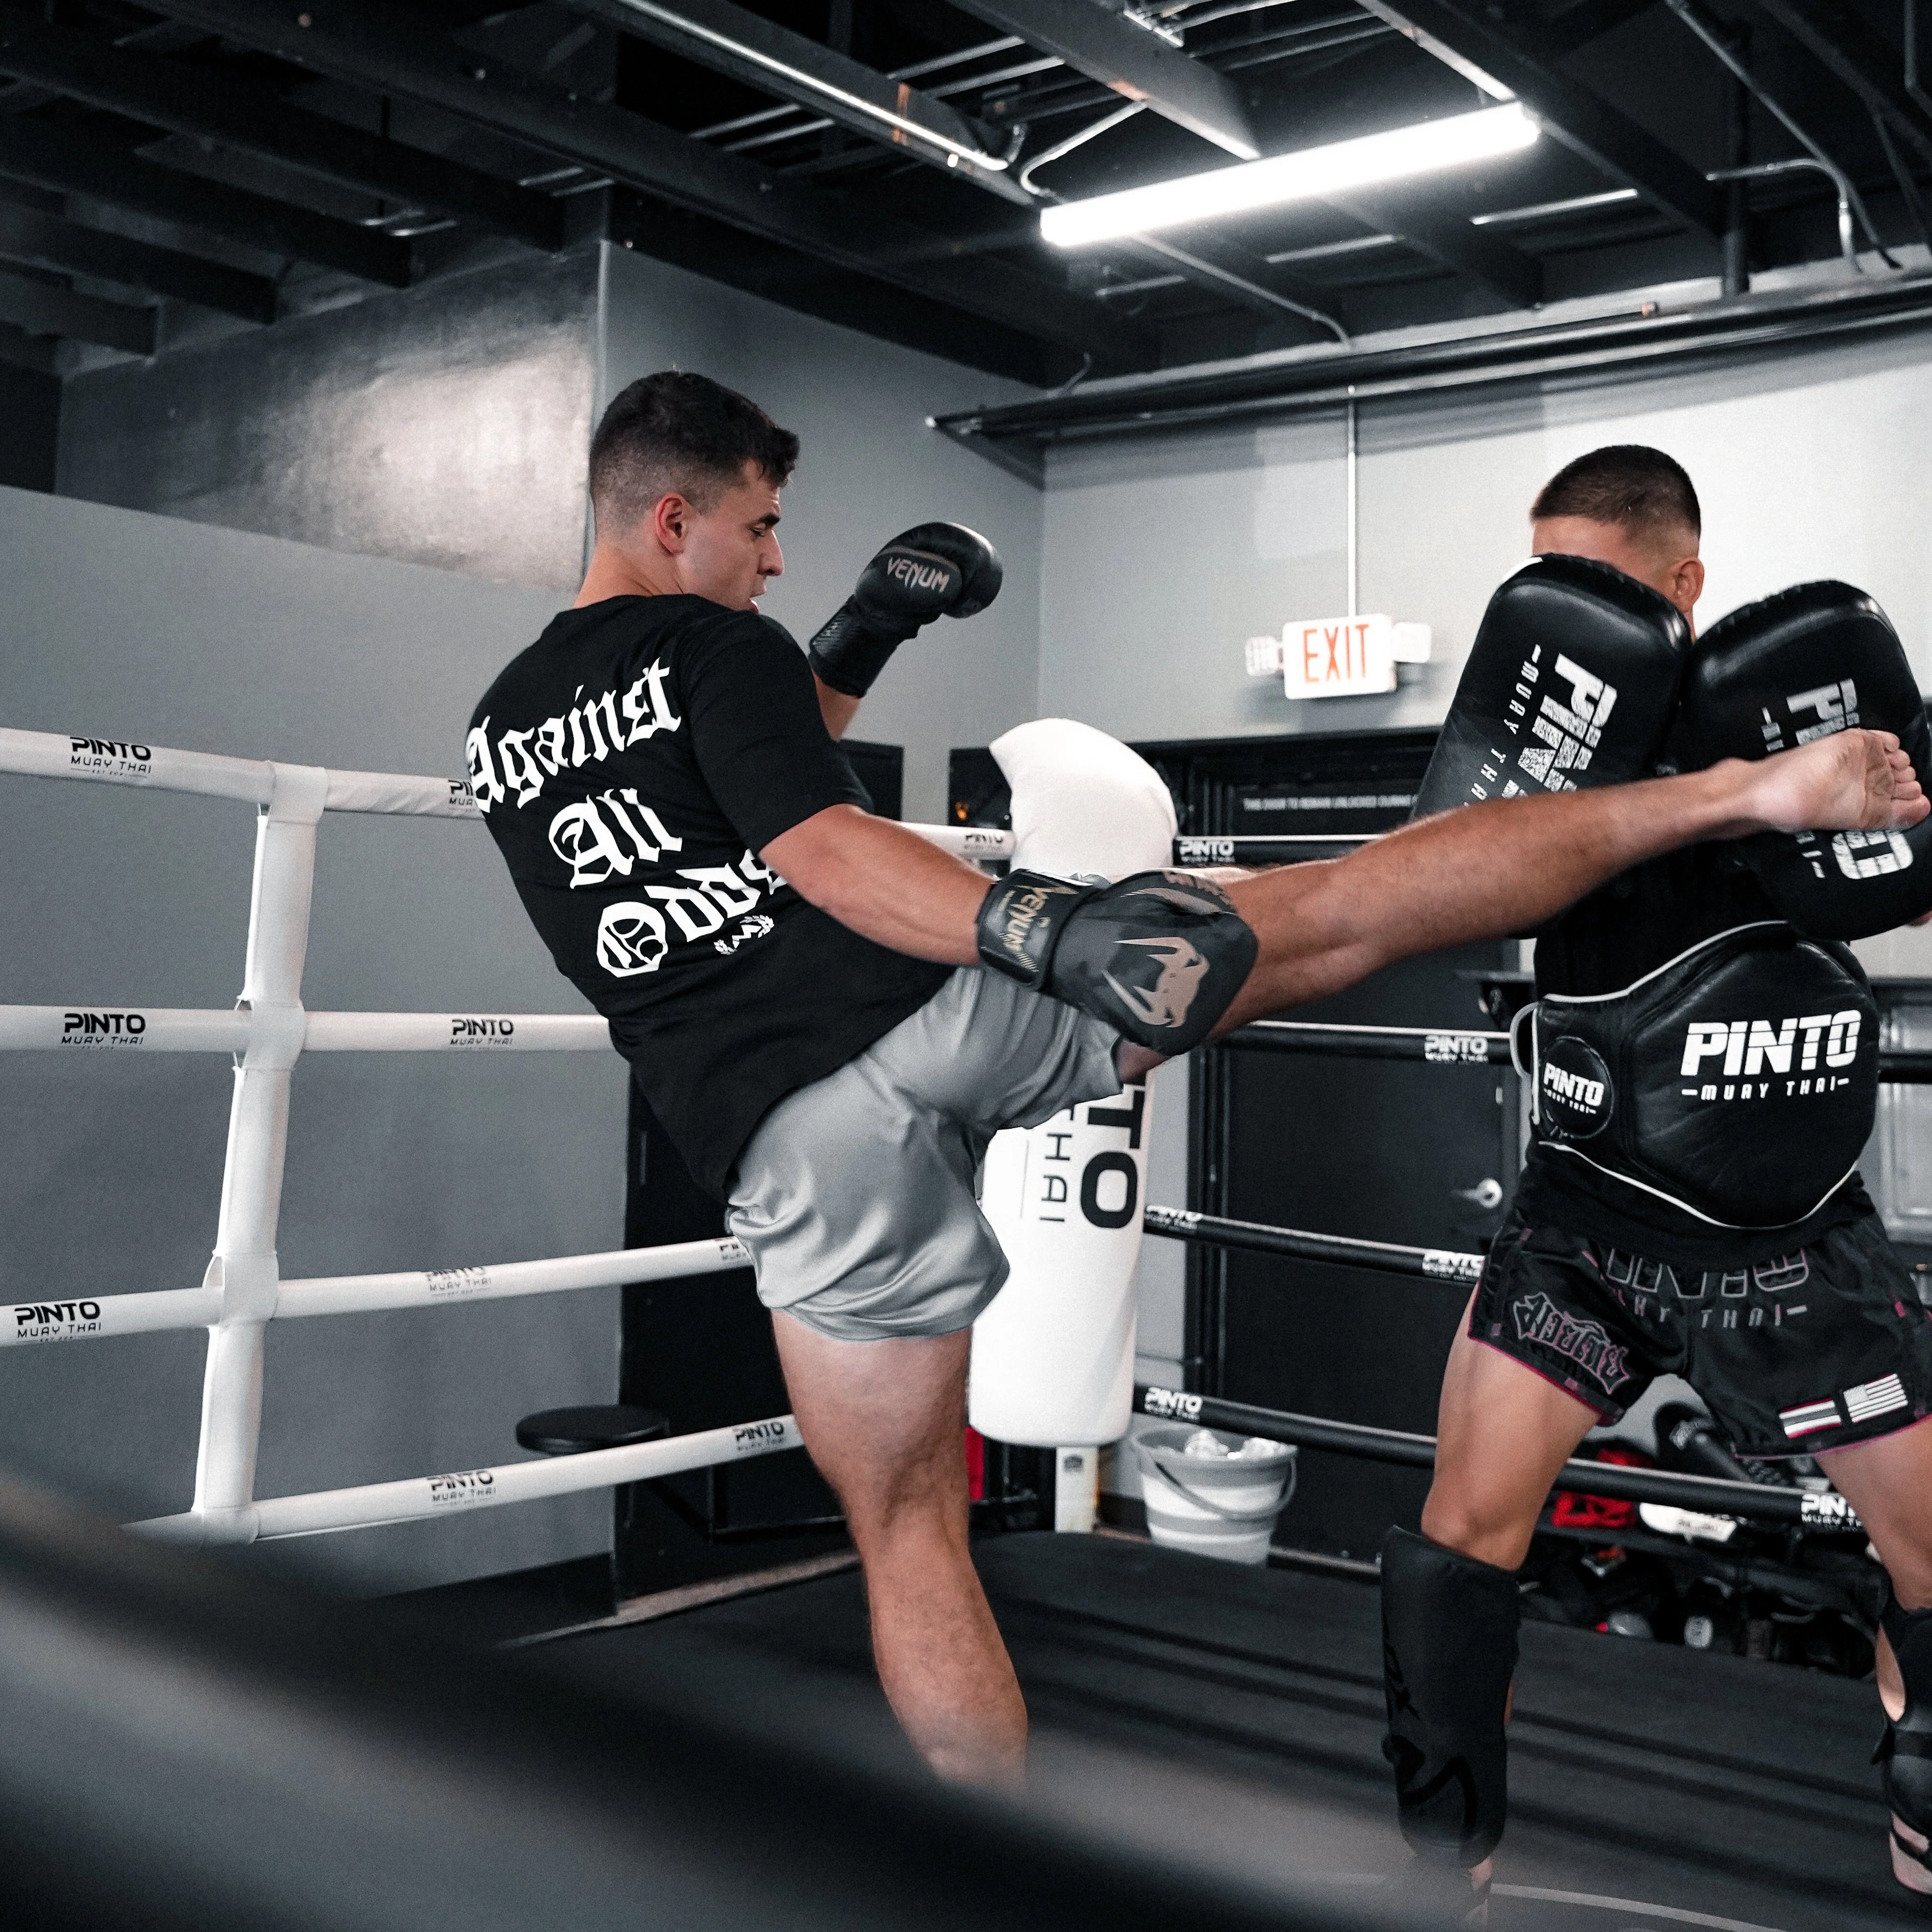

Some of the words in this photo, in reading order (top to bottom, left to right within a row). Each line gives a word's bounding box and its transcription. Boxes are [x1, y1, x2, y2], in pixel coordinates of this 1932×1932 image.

[887, 557, 950, 593] VENUM
[1303, 624, 1369, 684] EXIT
[465, 658, 682, 813] Against
[1501, 653, 1617, 800] PIN
[70, 737, 152, 761] PINTO
[71, 756, 112, 768] MUAY
[120, 761, 151, 773] THAI
[549, 788, 682, 889] All
[64, 1013, 146, 1034] PINTO
[452, 1018, 514, 1035] PINTO
[61, 1036, 104, 1044] MUAY
[111, 1036, 143, 1044] THAI
[1424, 1034, 1488, 1055] PINTO
[1681, 1010, 1861, 1076] PINTO
[1543, 1062, 1605, 1107] PINTO
[1039, 1105, 1075, 1222] HAI
[1080, 1080, 1146, 1229] TO
[14, 1302, 100, 1325] PINTO
[18, 1326, 60, 1338] MUAY
[68, 1322, 102, 1333] THAI
[1145, 1387, 1203, 1413] PINTO
[733, 1421, 784, 1441] PINTO
[427, 1470, 493, 1491] PINTO
